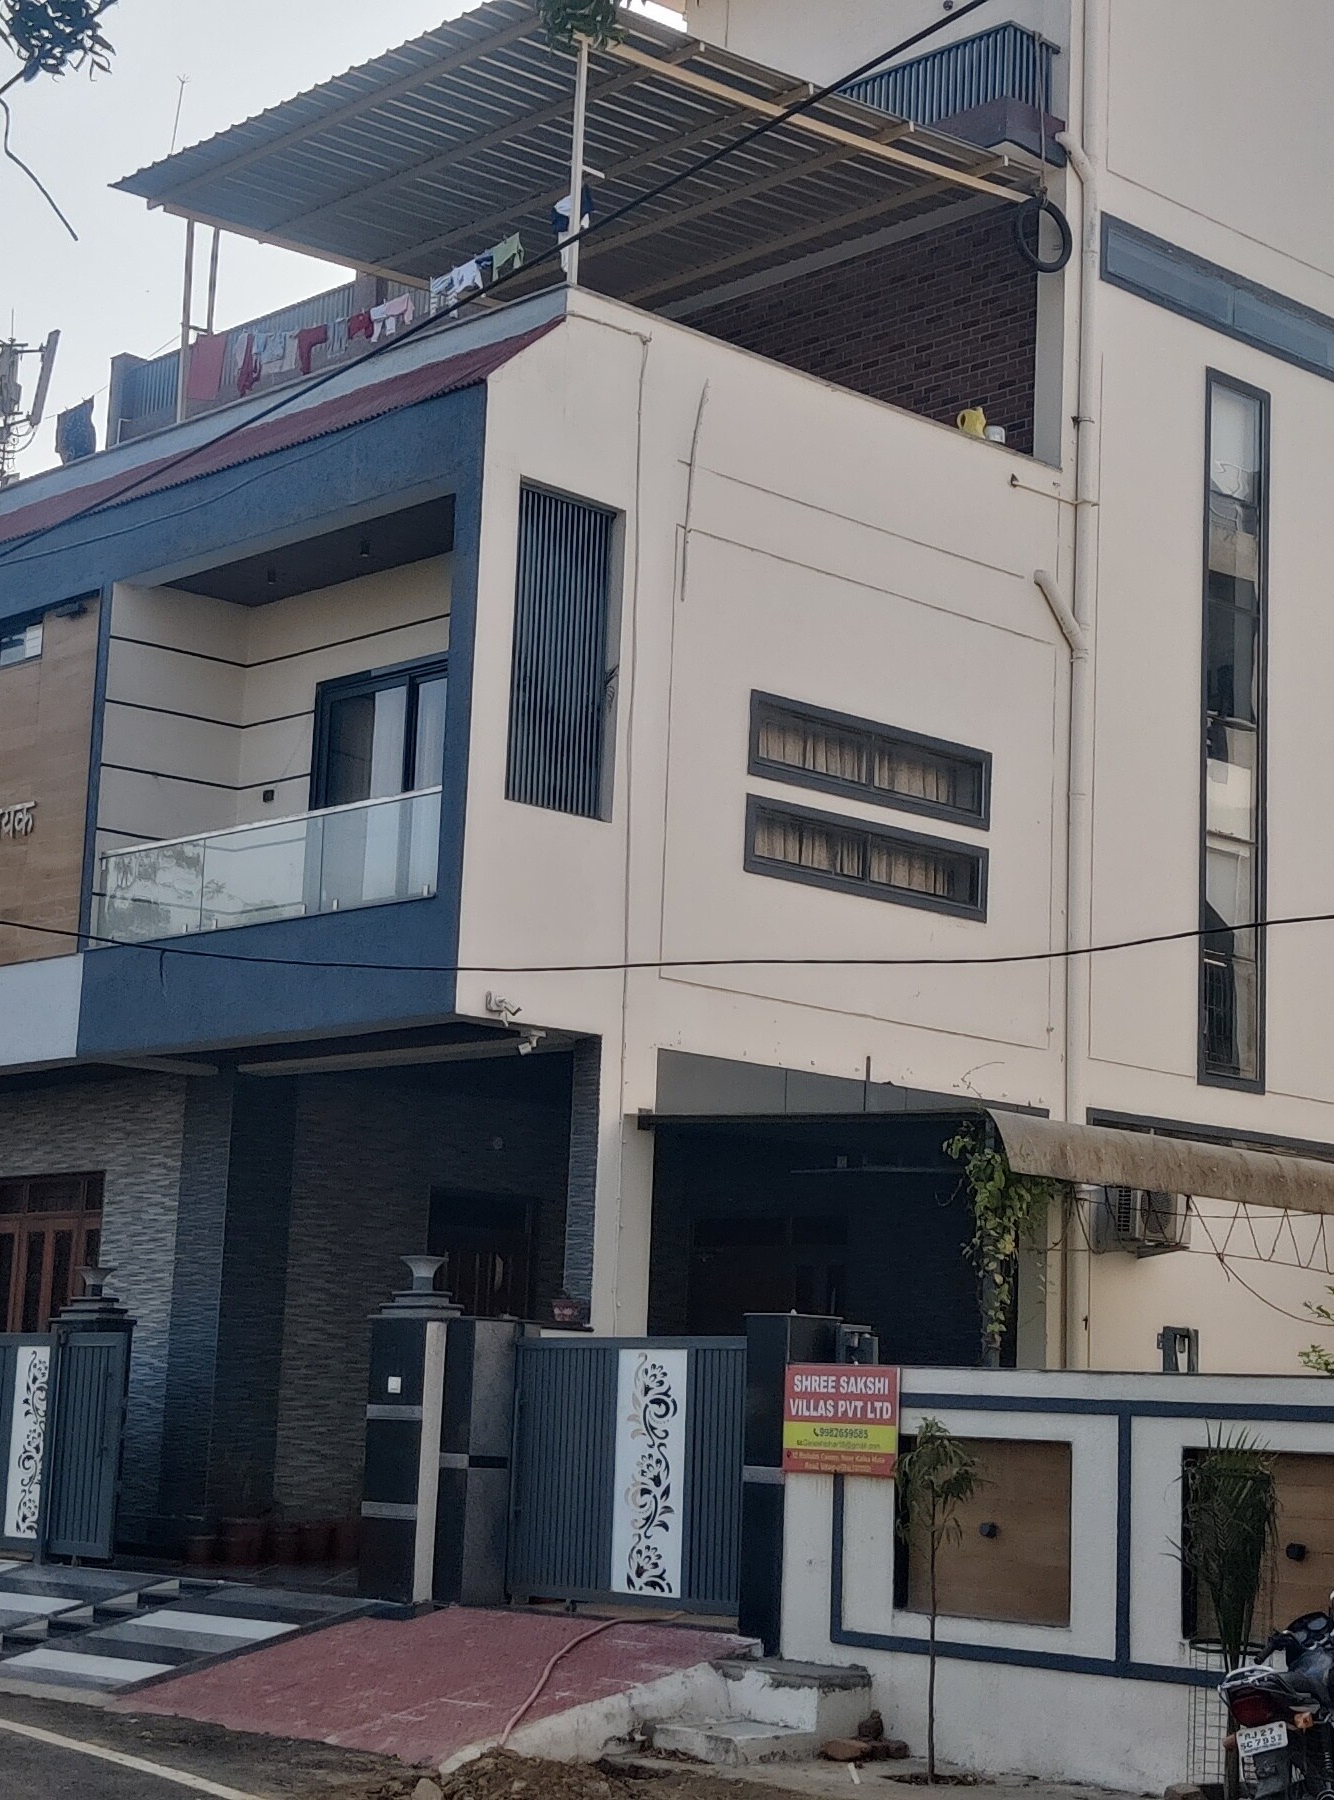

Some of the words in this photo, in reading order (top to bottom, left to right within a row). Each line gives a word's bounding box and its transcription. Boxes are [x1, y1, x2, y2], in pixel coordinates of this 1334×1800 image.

[793, 1374, 836, 1393] SHREE
[839, 1376, 889, 1395] SAKSHI
[789, 1398, 834, 1418] VILLAS
[837, 1400, 864, 1418] PVT
[867, 1401, 892, 1419] LTD
